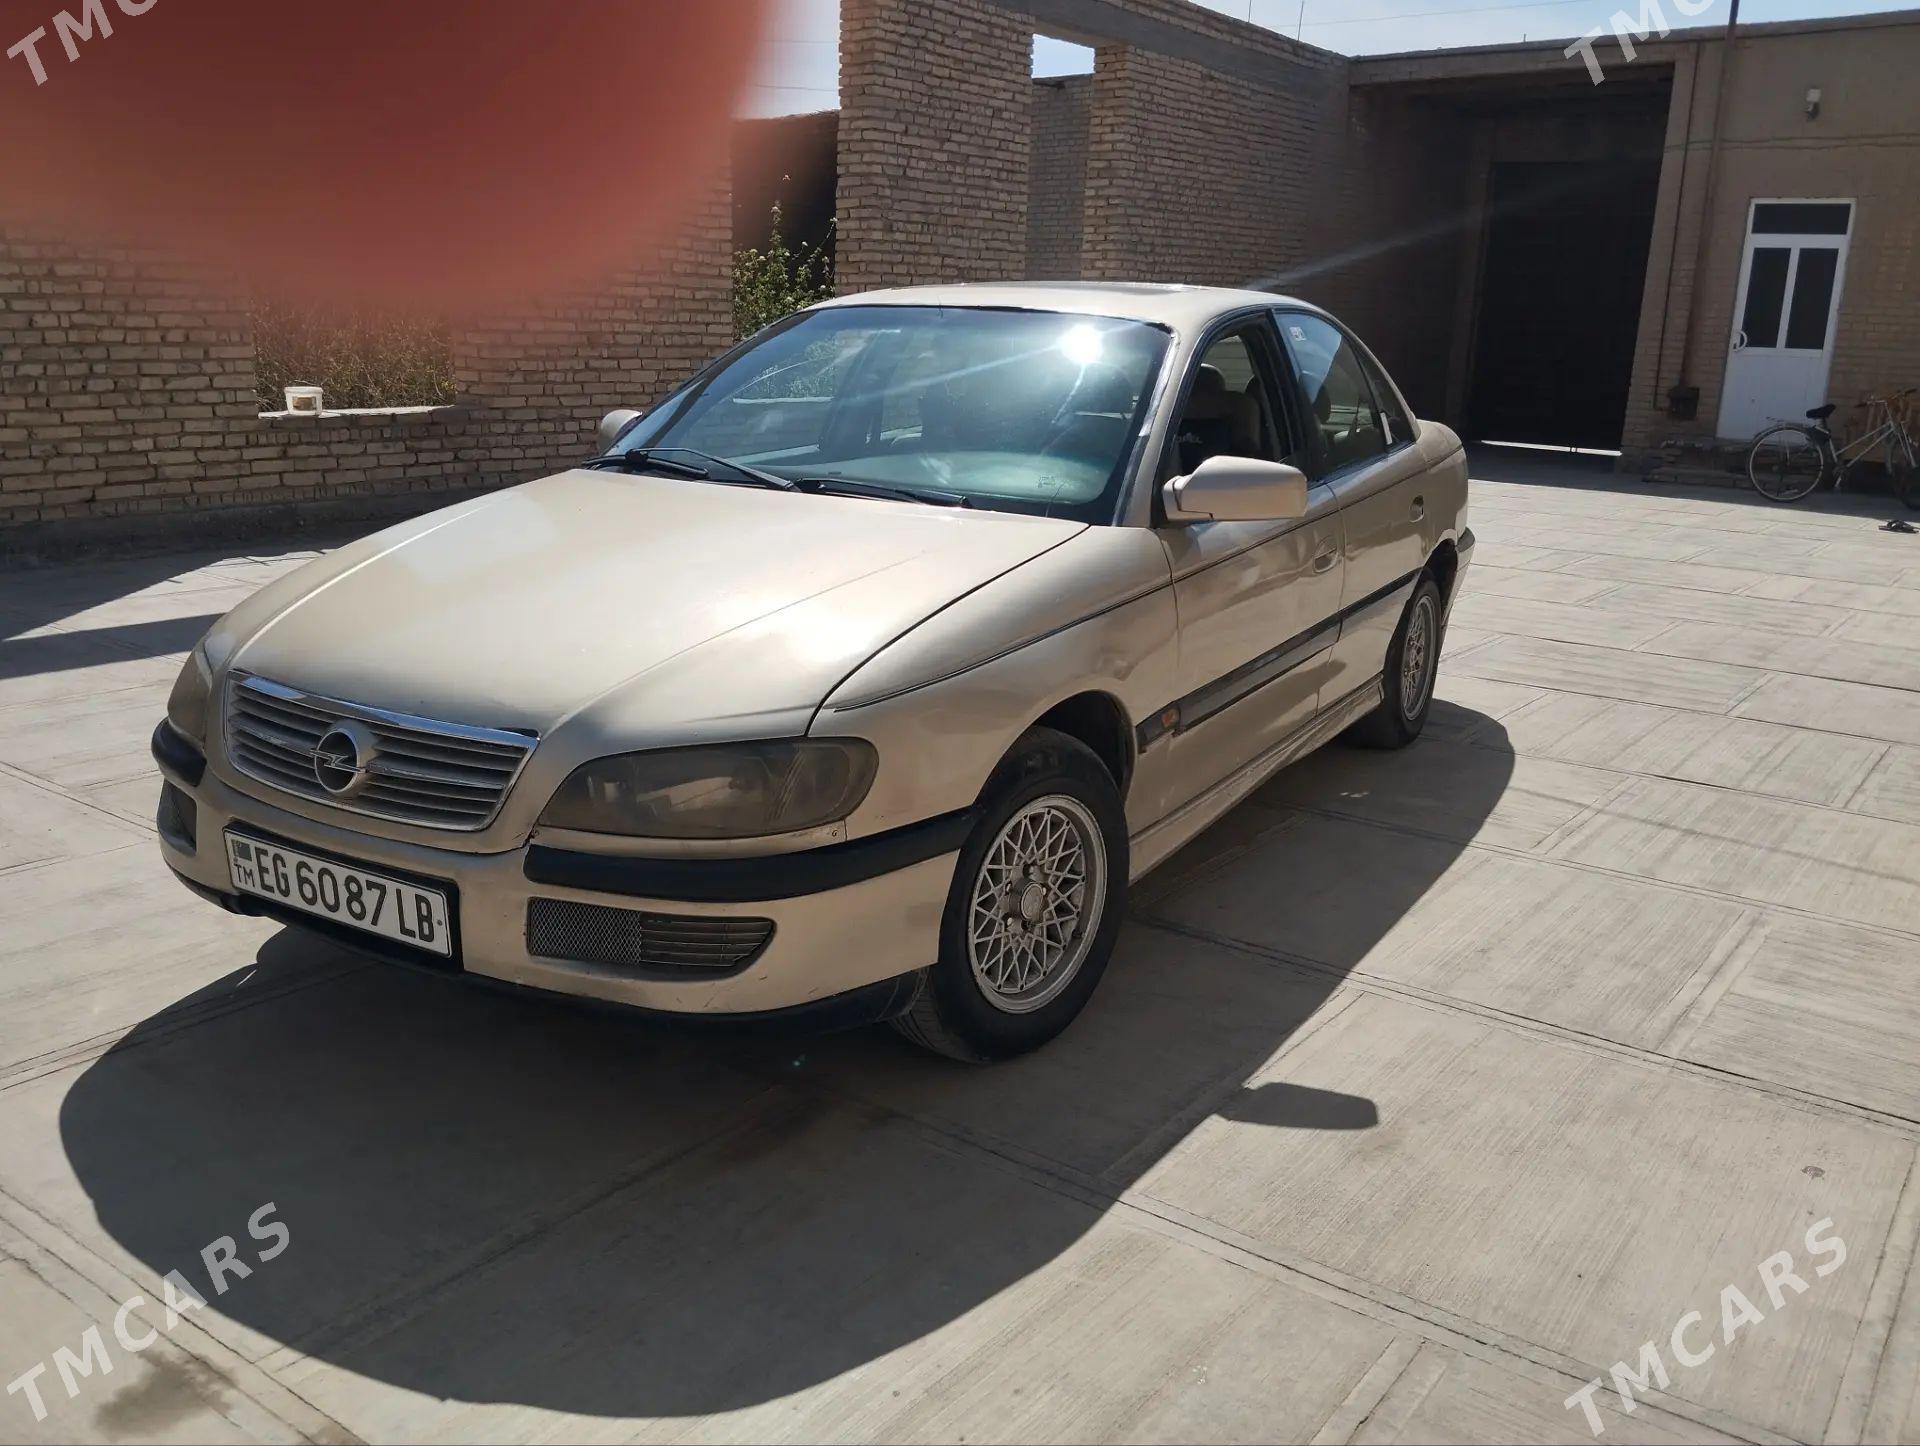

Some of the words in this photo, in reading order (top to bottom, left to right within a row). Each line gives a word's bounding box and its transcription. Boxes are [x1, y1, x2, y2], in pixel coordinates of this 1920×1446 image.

[233, 863, 255, 888] TM
[254, 846, 290, 898] EG
[296, 860, 387, 927] 6087
[396, 888, 435, 943] LB
